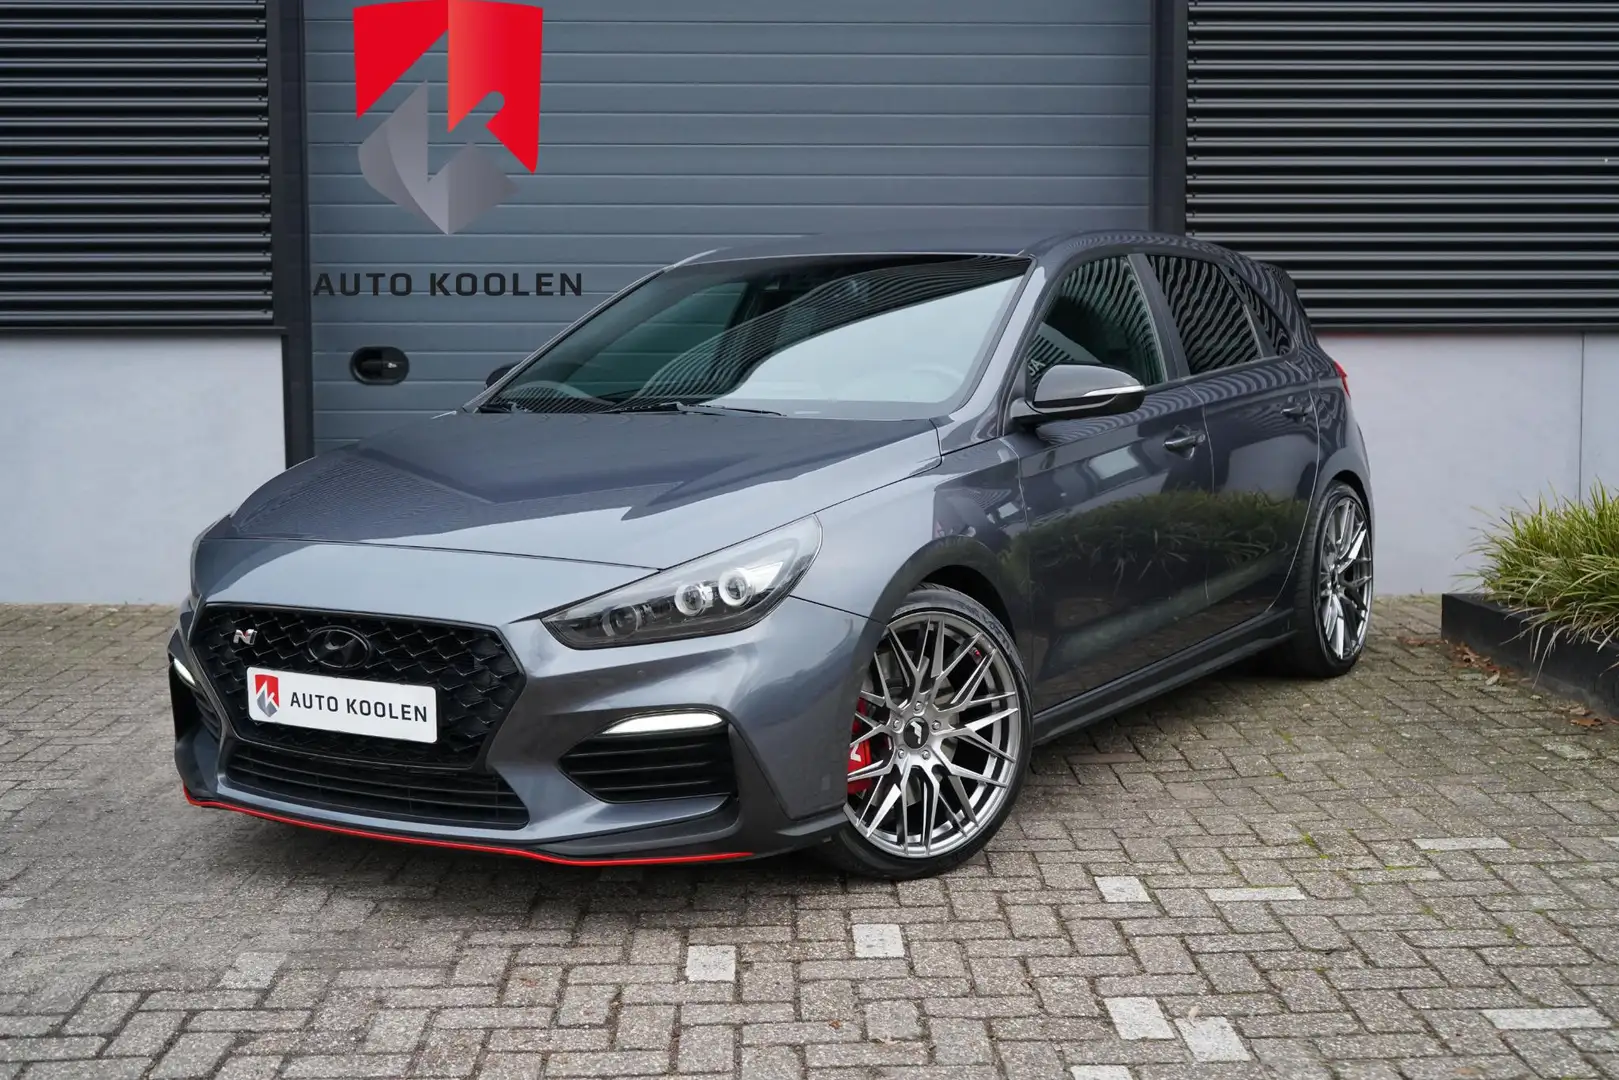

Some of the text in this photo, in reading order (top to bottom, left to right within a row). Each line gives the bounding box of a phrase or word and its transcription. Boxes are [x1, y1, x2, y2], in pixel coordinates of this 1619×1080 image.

[313, 273, 582, 296] AUTO KOOLEN
[233, 629, 257, 645] N
[290, 692, 428, 722] AUTO KOOLEN
